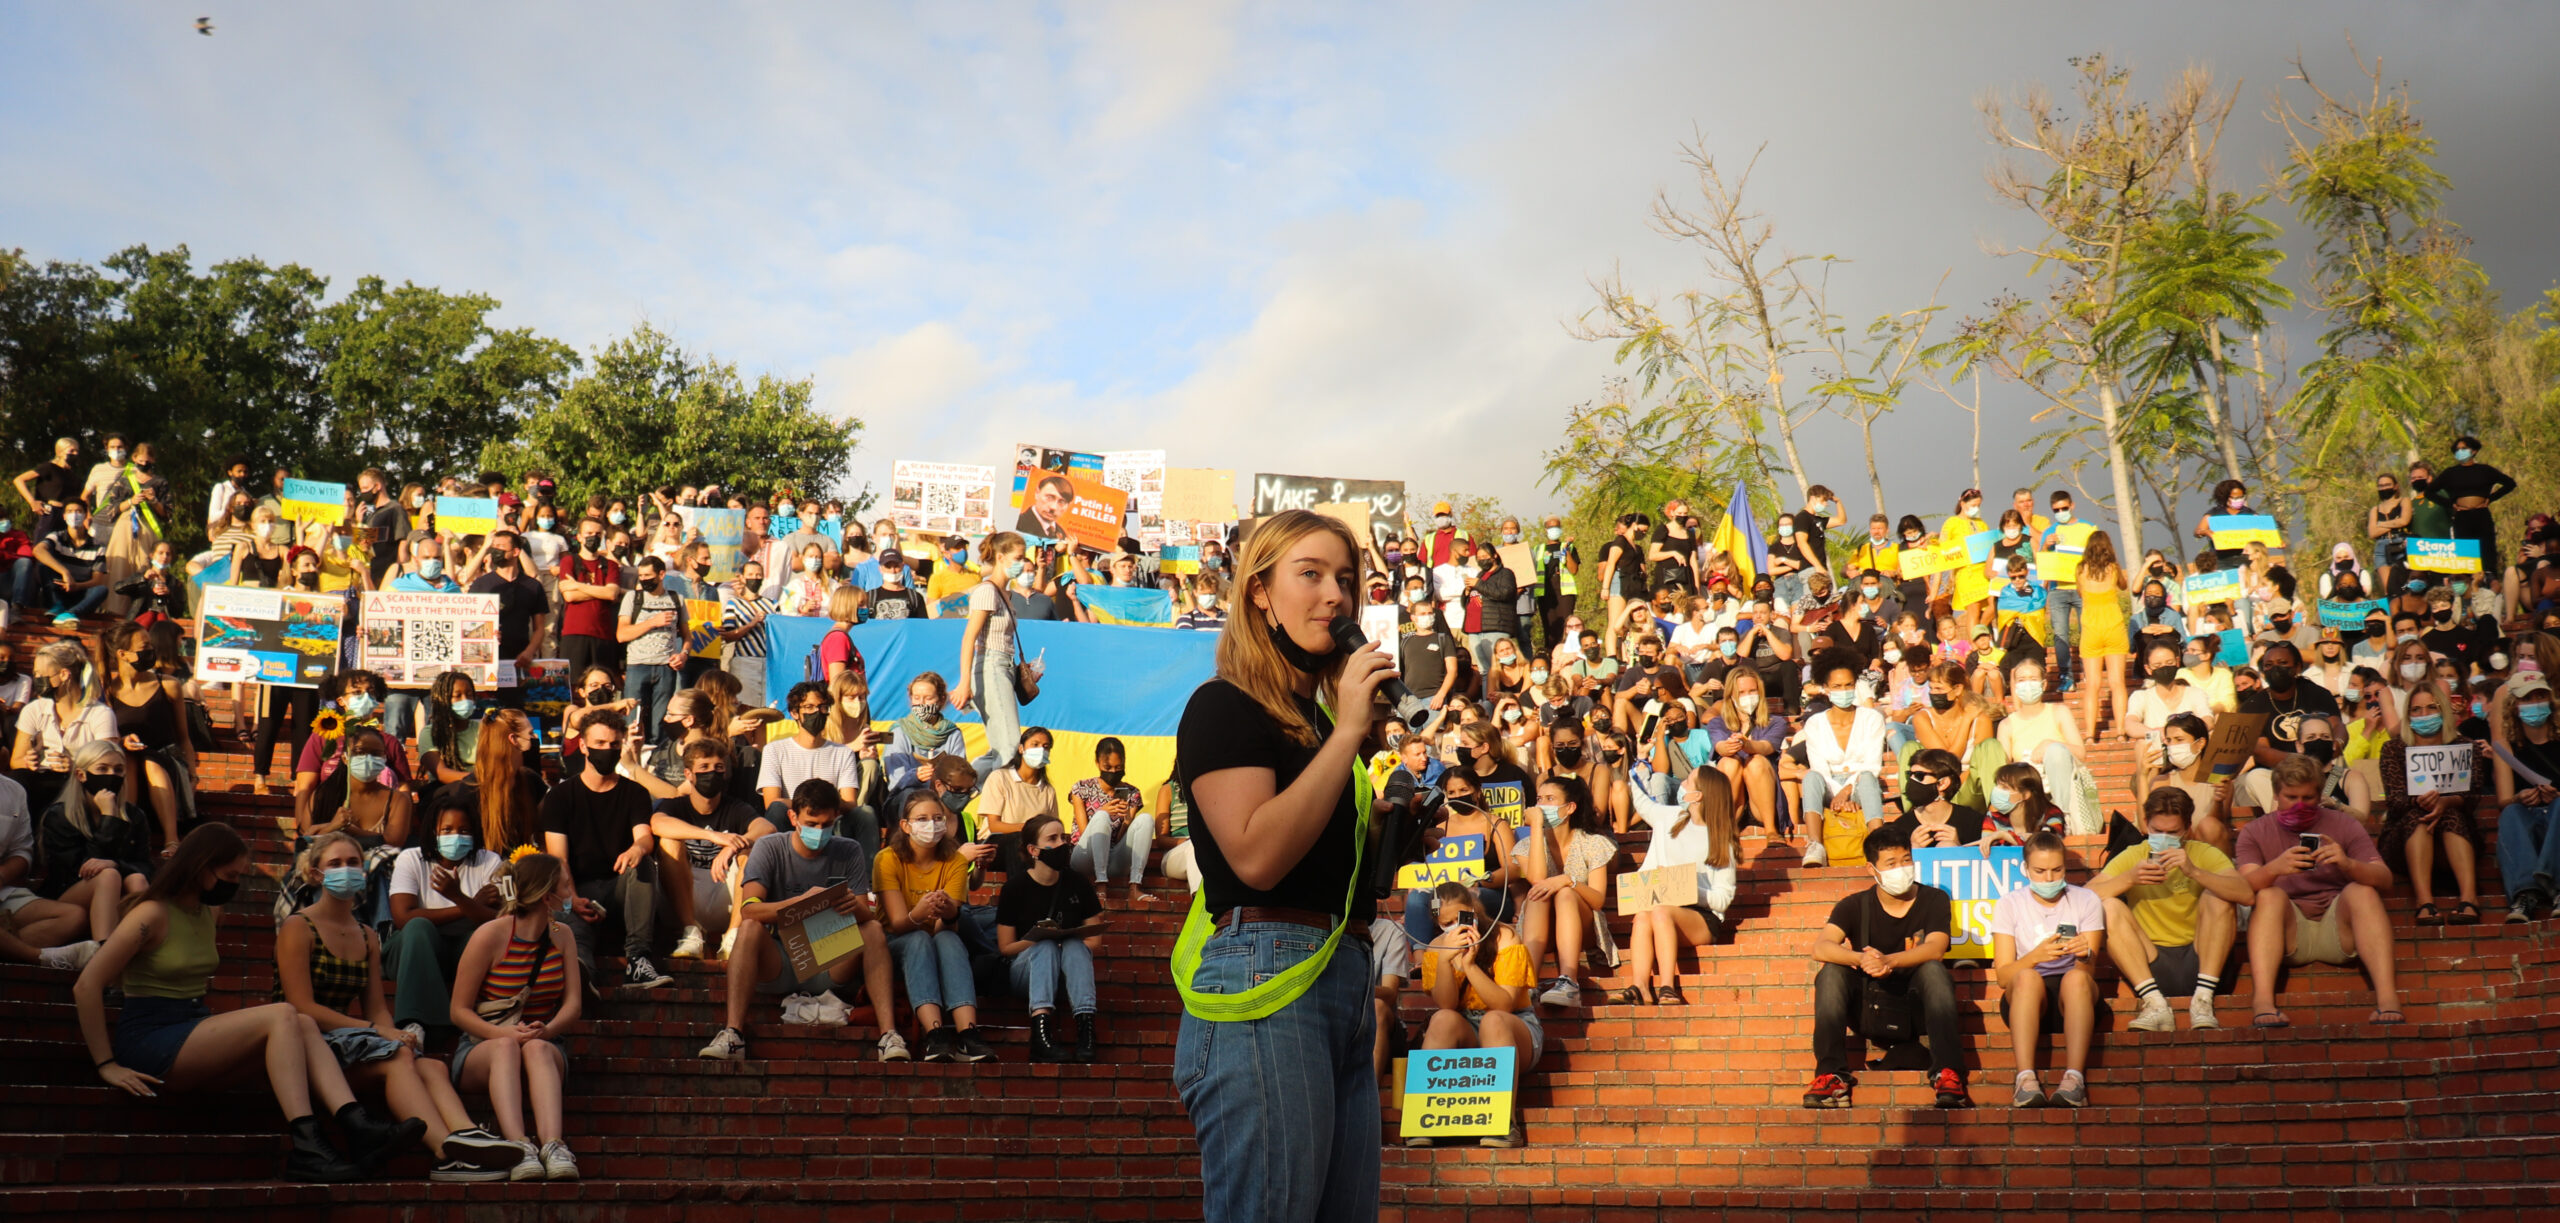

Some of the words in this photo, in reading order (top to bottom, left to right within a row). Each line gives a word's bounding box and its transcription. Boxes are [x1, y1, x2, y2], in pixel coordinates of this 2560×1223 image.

[1074, 496, 1103, 510] Putin
[1104, 503, 1114, 514] is
[1080, 508, 1118, 526] KILLER
[2416, 540, 2456, 552] Stand
[1911, 553, 1938, 570] STOP
[2414, 557, 2476, 571] UKRAINE
[386, 594, 412, 603] SCAN
[415, 595, 433, 604] THE
[436, 596, 452, 605] QR
[453, 596, 478, 605] CODE
[390, 606, 403, 614] TO
[405, 606, 423, 615] SEE
[424, 607, 443, 615] THE
[445, 607, 477, 616] TRUTH
[687, 599, 720, 622] NO
[1365, 619, 1391, 641] AR
[2411, 751, 2445, 773] STOP
[2449, 748, 2473, 771] WAR
[1618, 869, 1661, 889] LOVE
[784, 899, 830, 927] STAND
[1426, 1055, 1498, 1073] Слава
[1425, 1096, 1492, 1109] Героям
[1419, 1112, 1493, 1129] Слава!
